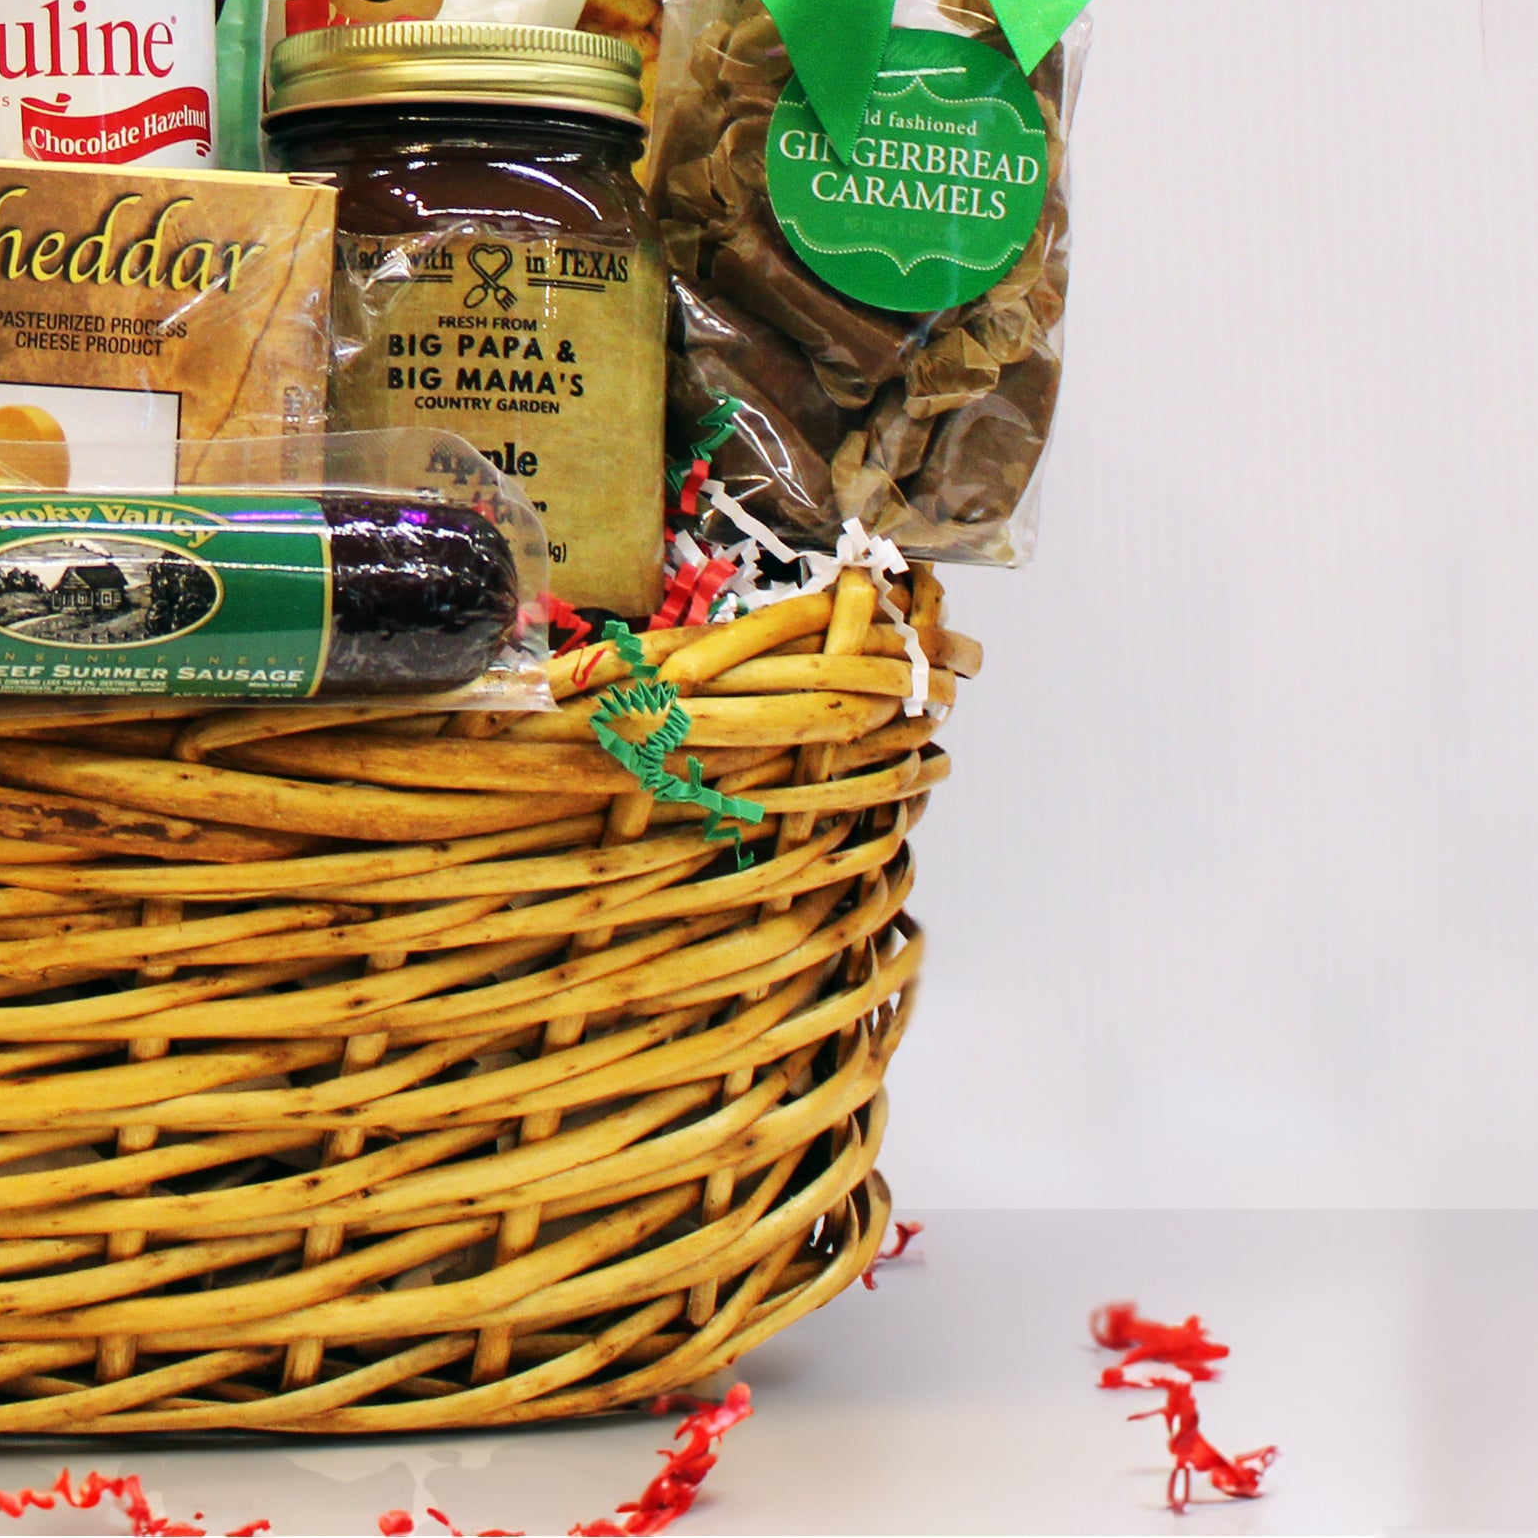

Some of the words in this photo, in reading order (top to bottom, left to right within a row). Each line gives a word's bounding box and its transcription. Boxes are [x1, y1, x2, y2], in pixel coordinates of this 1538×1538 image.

[29, 125, 140, 157] Chocolate
[142, 104, 208, 140] Hazelnut
[863, 108, 882, 126] ld
[888, 110, 978, 137] fashioned
[811, 171, 1007, 221] CARAMELS
[525, 248, 546, 274] in
[558, 248, 629, 283] TEXAS
[110, 317, 188, 340] PROCESS
[437, 315, 489, 330] FRESH
[493, 317, 538, 332] FROM
[15, 330, 82, 352] CHEESE
[85, 334, 163, 357] PRODUCT
[388, 334, 443, 358] BIG
[457, 335, 544, 361] PAPA
[557, 339, 578, 363] &
[388, 367, 443, 391] BIG
[457, 369, 584, 397] MAMA'S
[414, 396, 493, 411] COUNTRY
[497, 398, 561, 414] GARDEN
[94, 503, 219, 549] Valley
[52, 664, 169, 679] SUMMER
[176, 666, 306, 682] SAUSAGE
